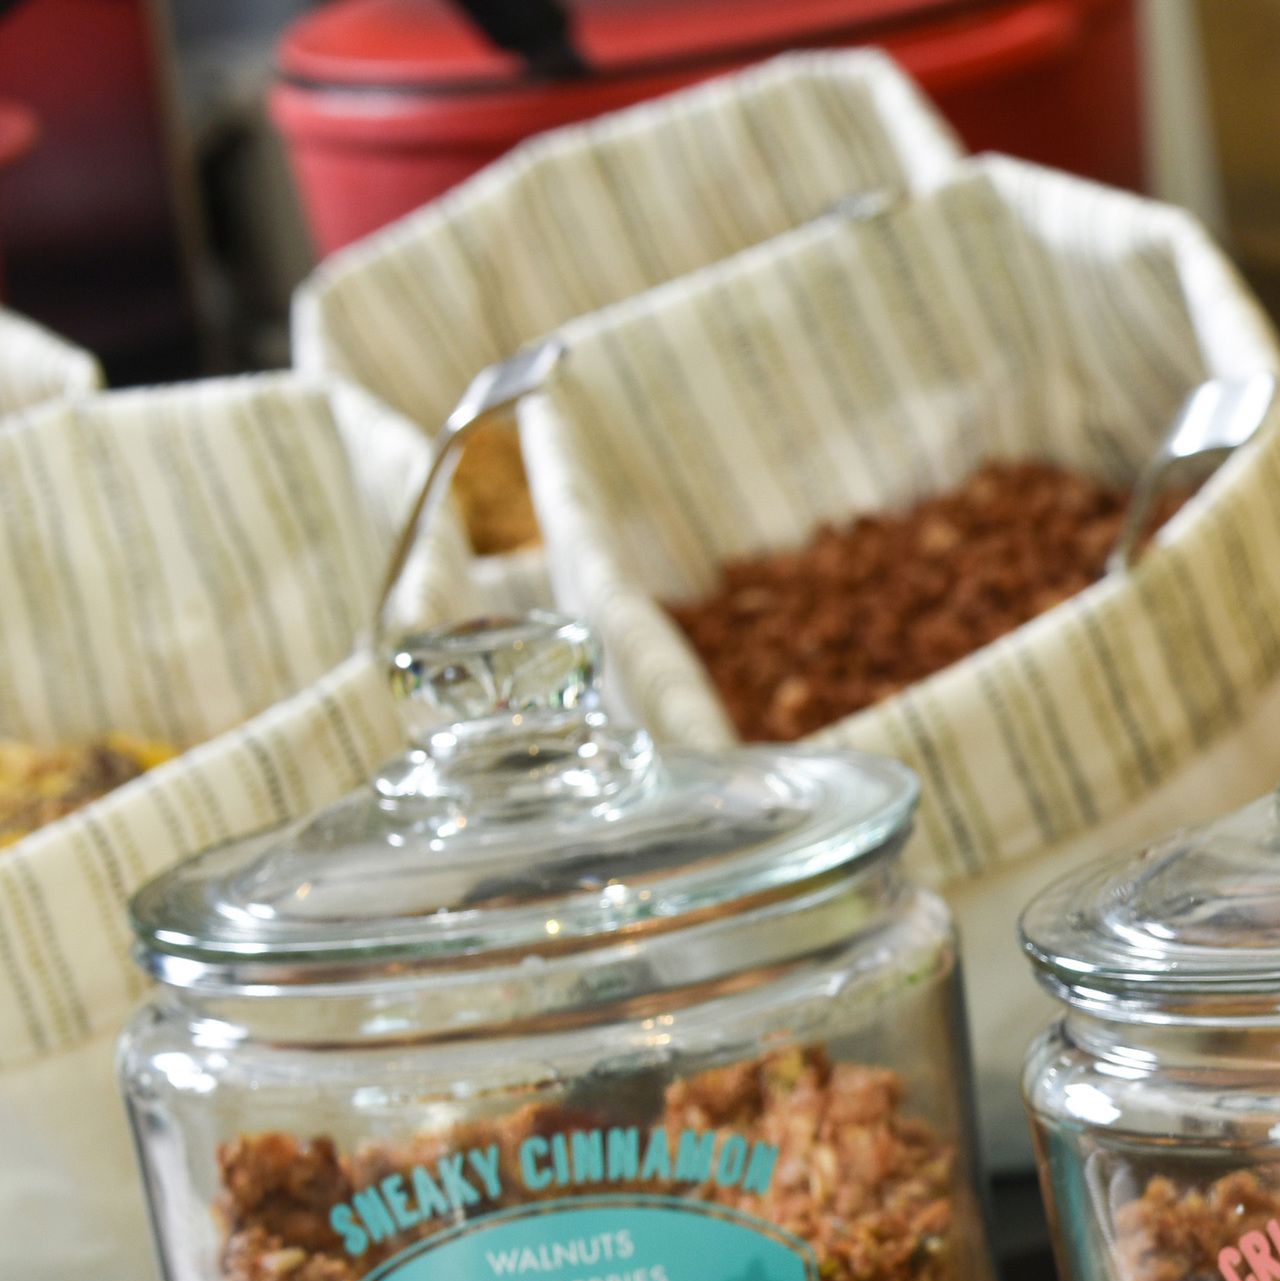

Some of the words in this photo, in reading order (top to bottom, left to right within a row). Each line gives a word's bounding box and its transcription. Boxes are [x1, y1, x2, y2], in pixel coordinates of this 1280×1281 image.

[328, 1145, 502, 1256] SNEAKY
[518, 1126, 780, 1195] CINNAMON
[485, 1230, 635, 1276] WALNUTS
